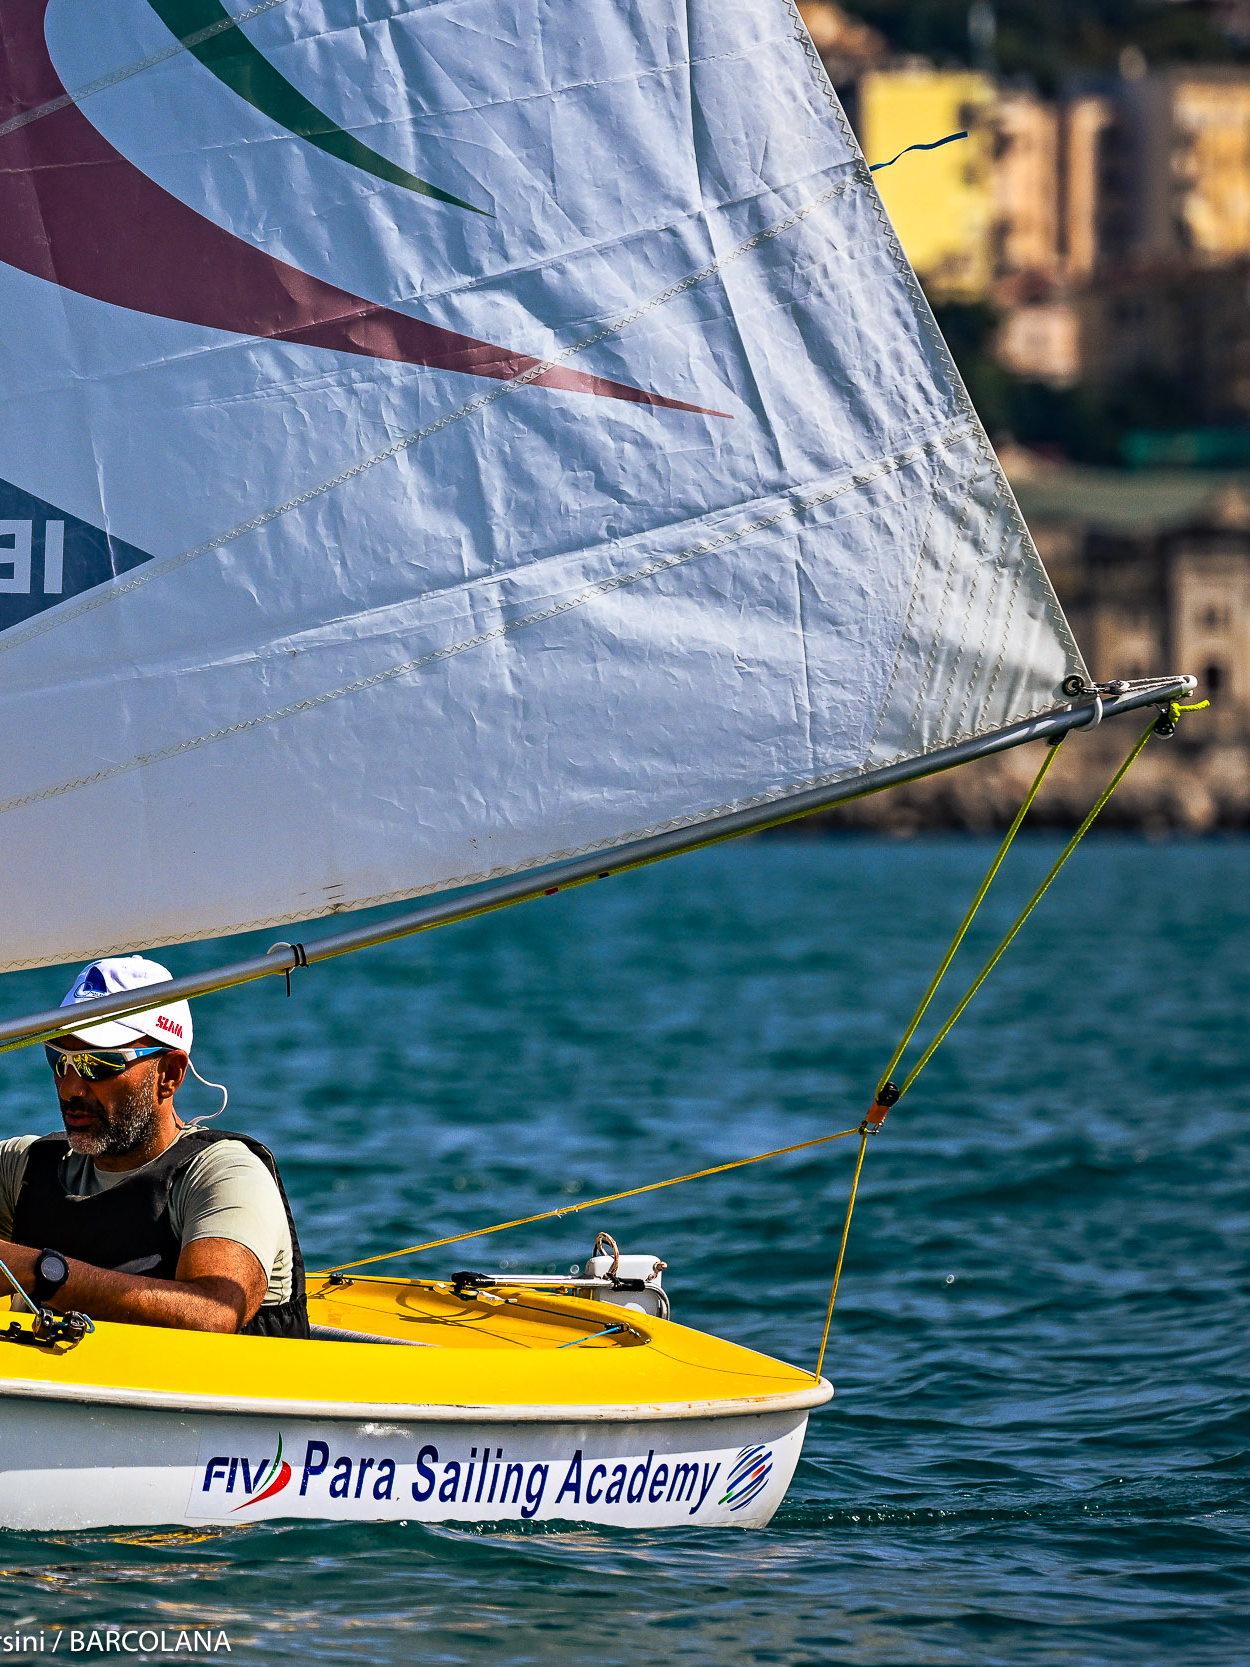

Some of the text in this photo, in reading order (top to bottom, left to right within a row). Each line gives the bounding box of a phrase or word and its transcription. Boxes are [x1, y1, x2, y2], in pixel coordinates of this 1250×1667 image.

[155, 1015, 184, 1039] SLAM
[202, 1440, 721, 1519] FIV Para Sailing Academy
